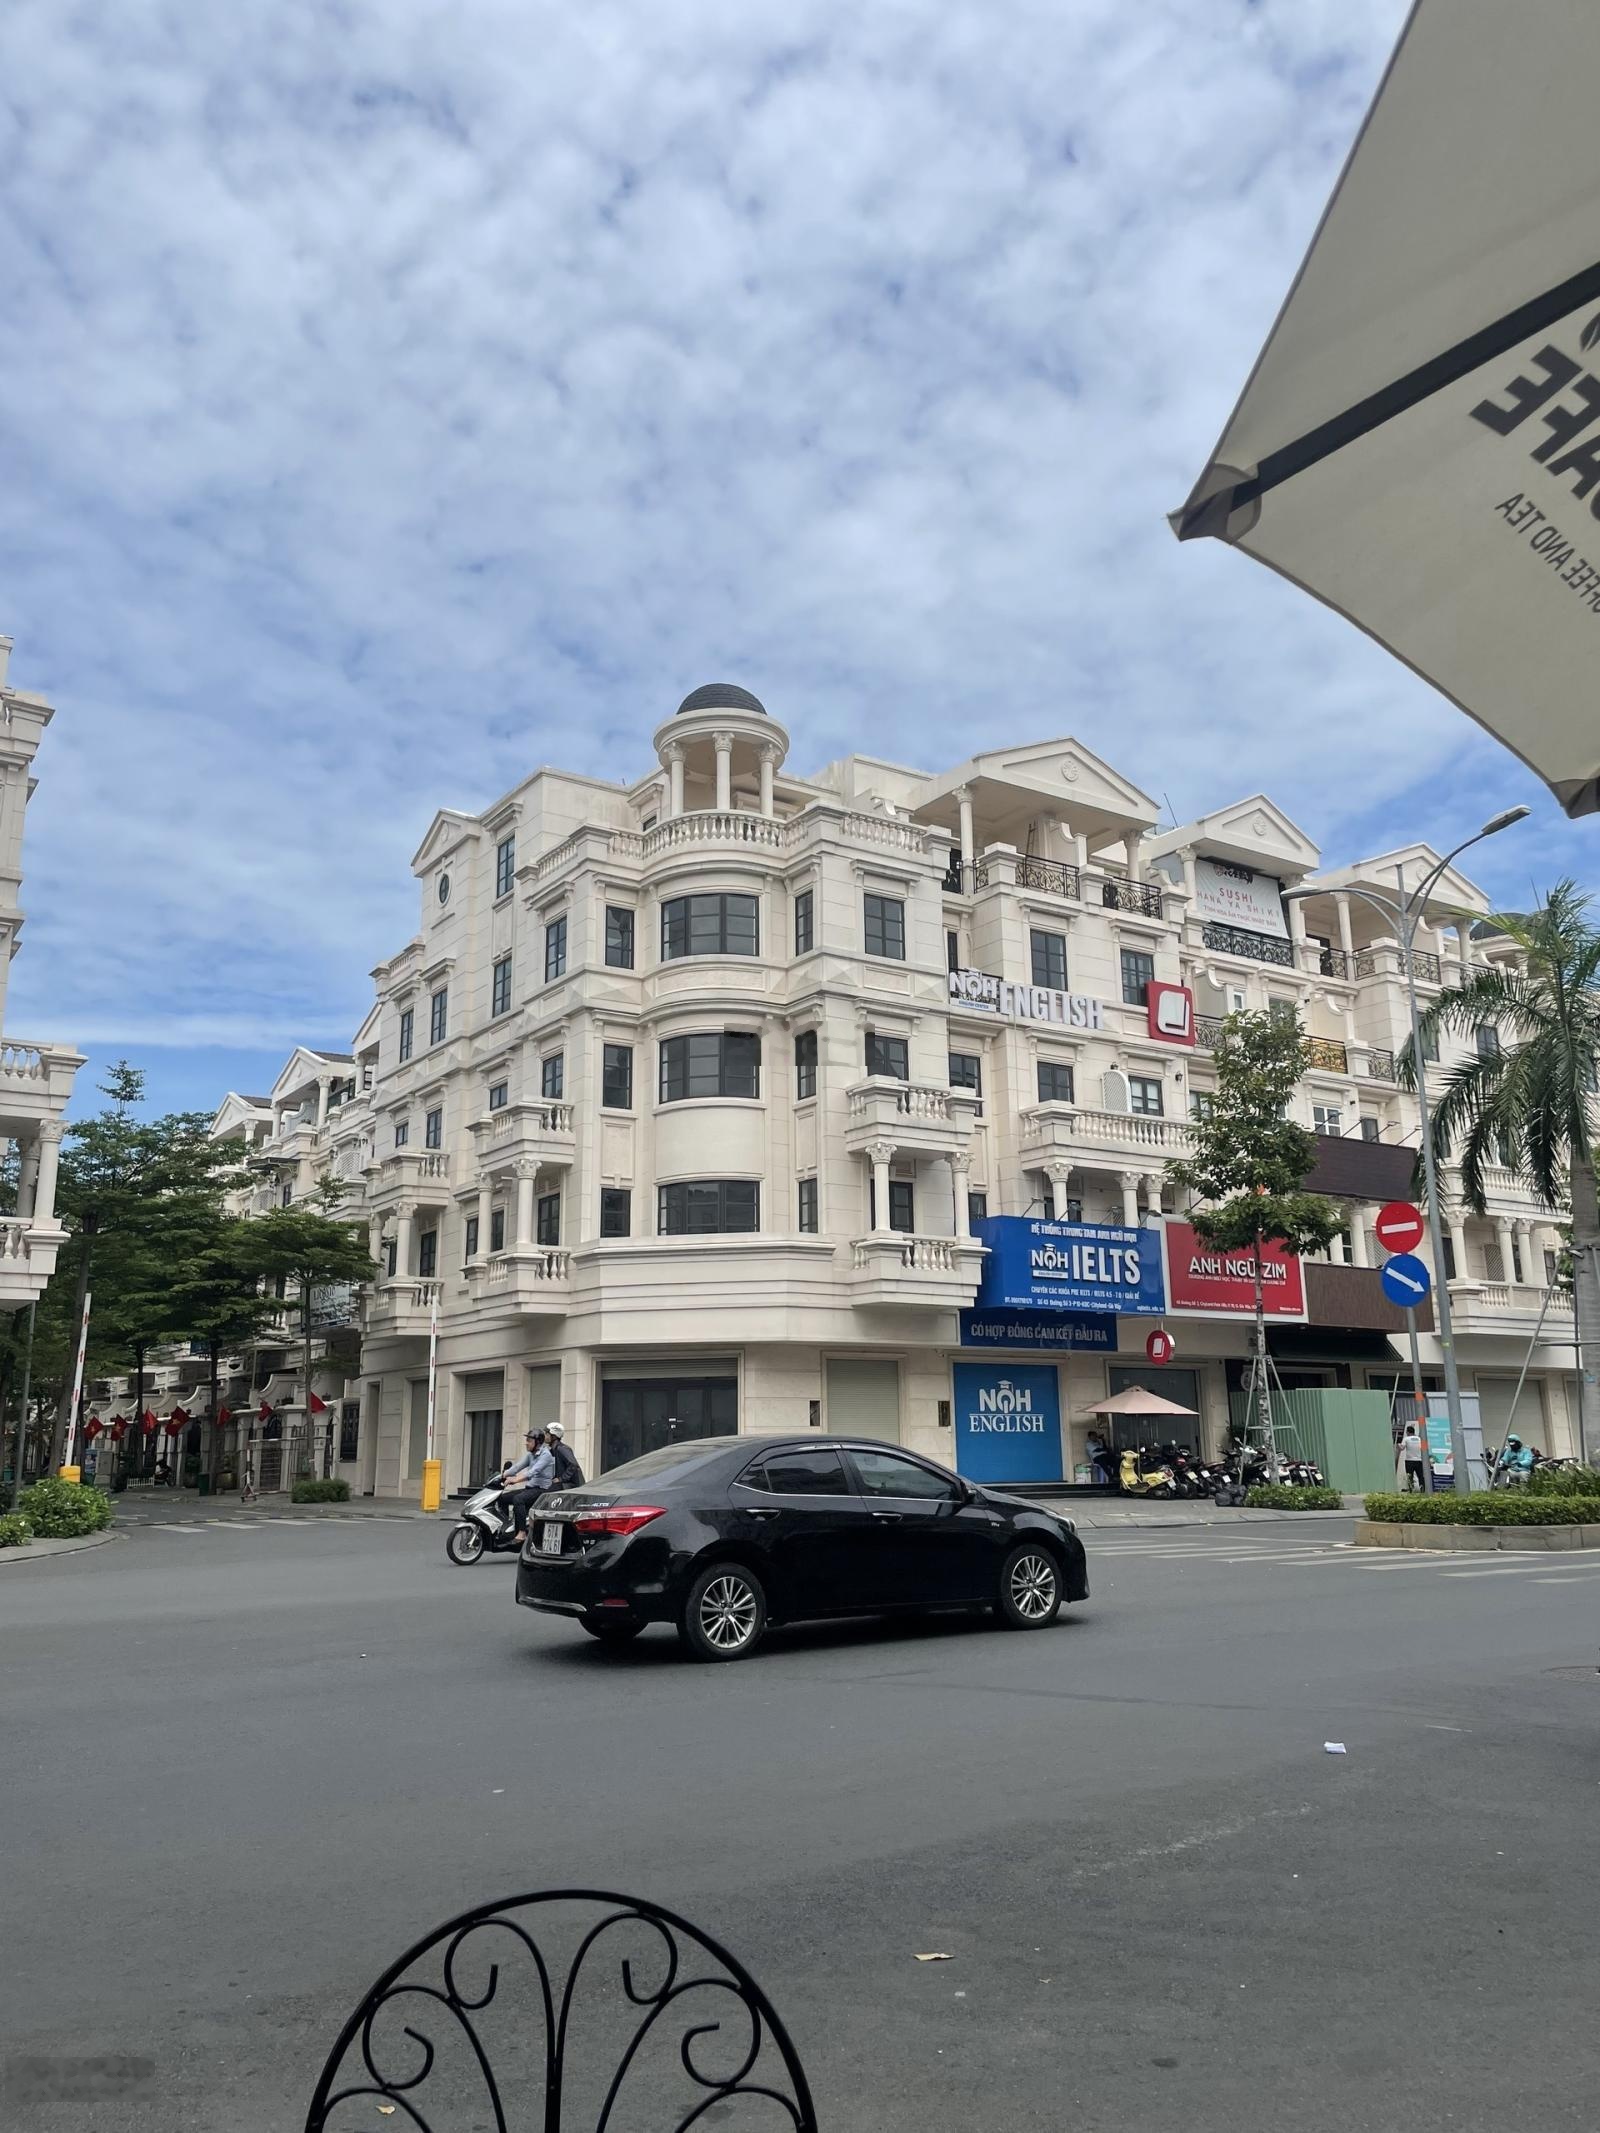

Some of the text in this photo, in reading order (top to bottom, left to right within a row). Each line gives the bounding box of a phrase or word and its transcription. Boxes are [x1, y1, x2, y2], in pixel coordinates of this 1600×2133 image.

[1197, 891, 1222, 905] HANA
[1229, 901, 1241, 910] YA
[1219, 887, 1253, 904] SUSHI
[1000, 980, 1105, 1030] ENGLISH
[1072, 1245, 1142, 1285] IELTS
[1189, 1256, 1221, 1274] ANH
[1263, 1262, 1287, 1280] ZIM
[971, 1321, 985, 1337] CÓ
[985, 1324, 1005, 1341] HỢP
[1094, 1329, 1108, 1343] RA
[969, 1414, 1045, 1433] ENGLISH
